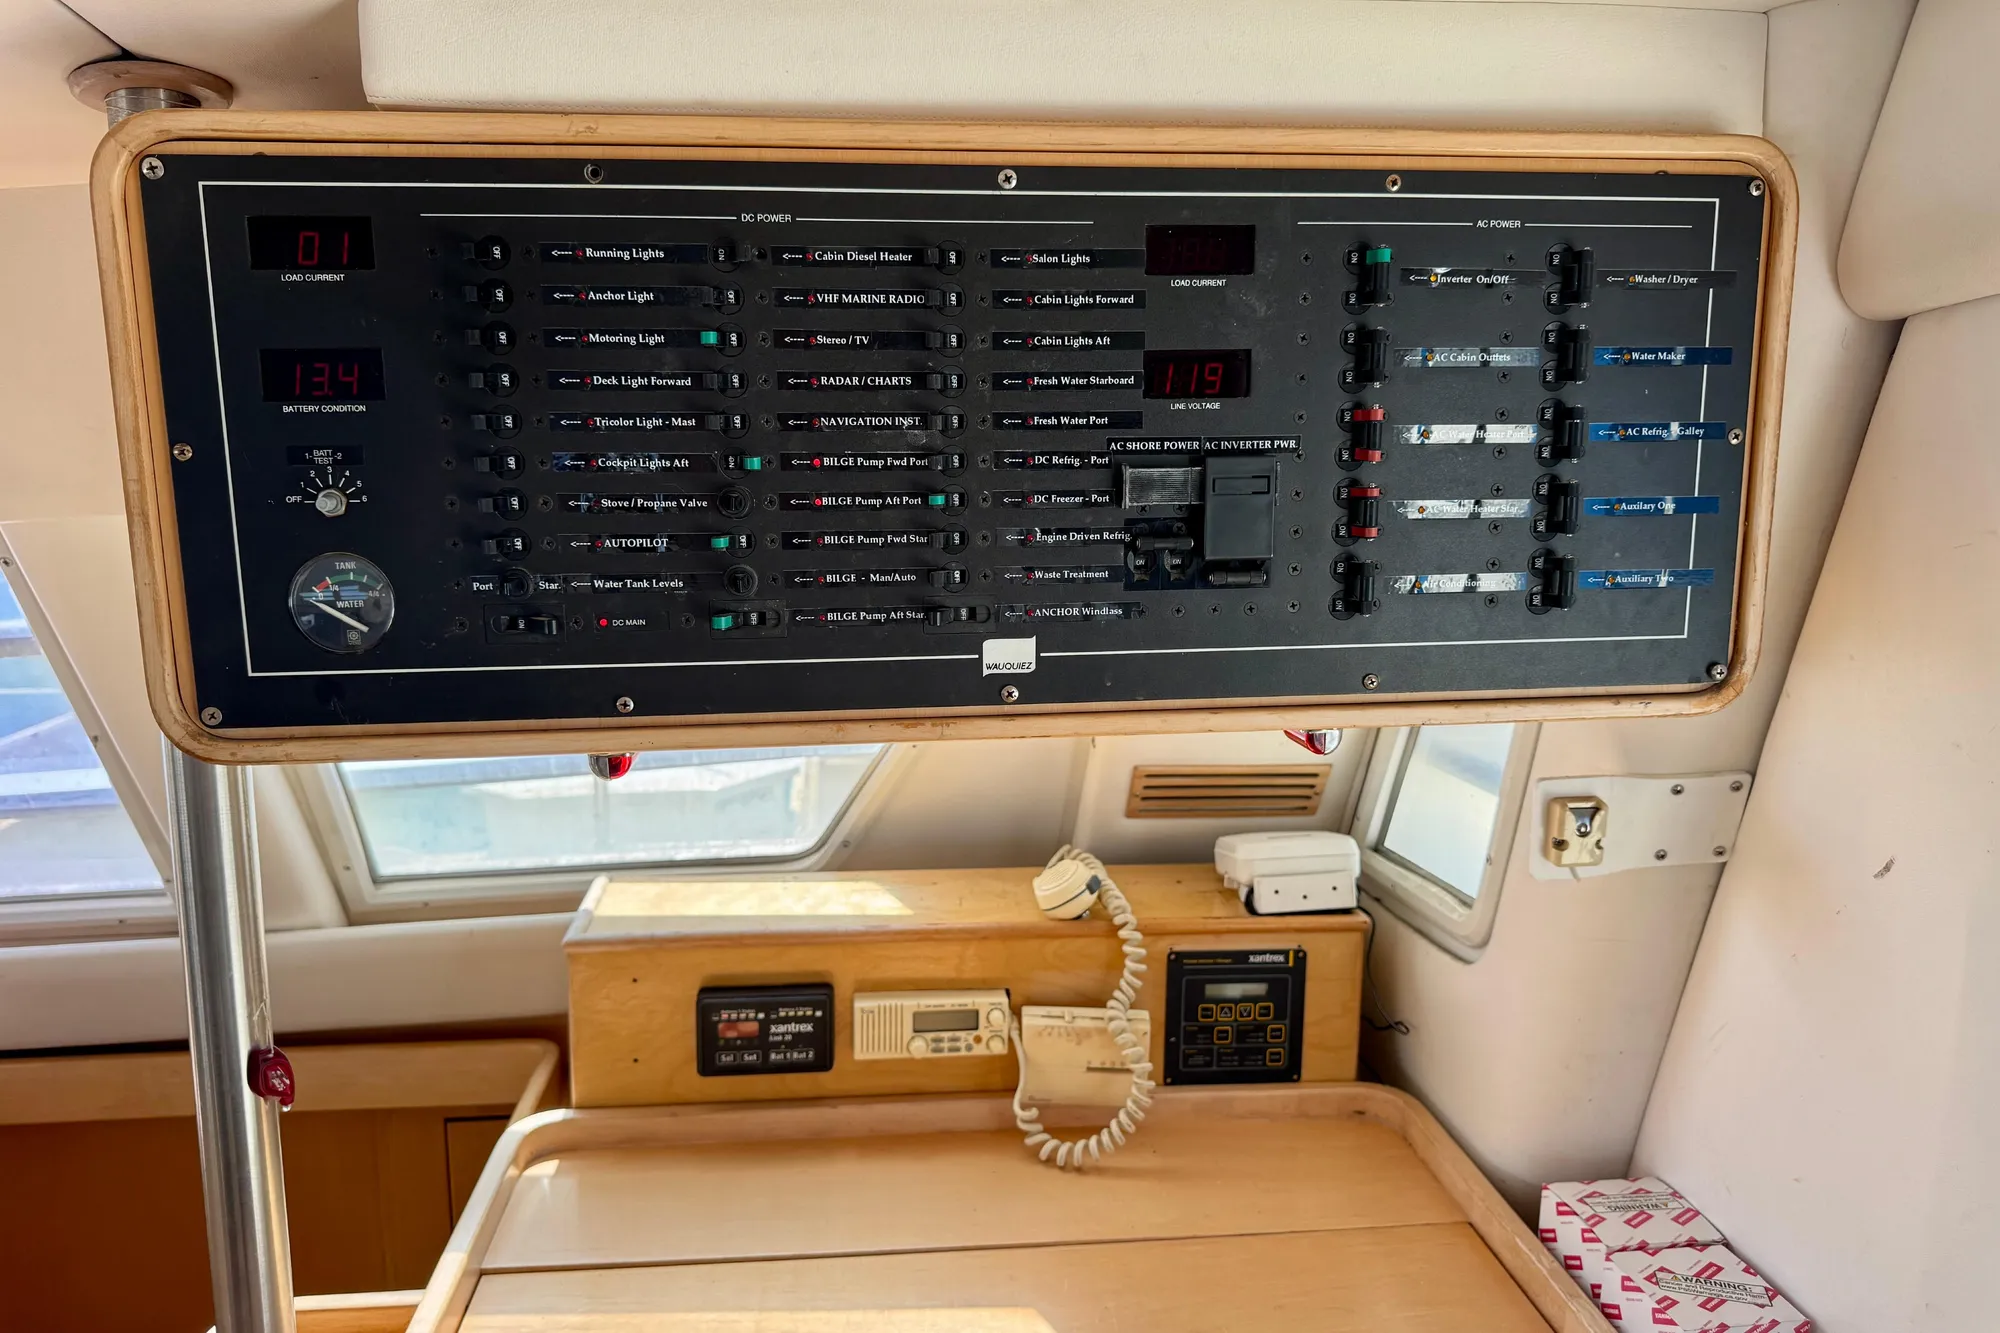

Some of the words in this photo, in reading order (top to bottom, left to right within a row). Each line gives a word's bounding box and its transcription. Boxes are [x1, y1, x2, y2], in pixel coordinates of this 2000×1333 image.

[742, 214, 754, 222] DC
[756, 214, 791, 222] POWER
[1490, 220, 1520, 228] POWER
[586, 248, 630, 260] Running
[633, 249, 664, 260] Lights
[815, 252, 843, 260] Cabin
[847, 252, 876, 260] Diesel
[880, 252, 912, 260] Heater
[1033, 254, 1058, 262] Salon
[1062, 254, 1090, 265] Lights
[1438, 275, 1472, 283] Inverter
[1477, 275, 1509, 283] On/Off
[1635, 275, 1666, 283] Washer
[1673, 275, 1698, 286] Dryer
[589, 291, 624, 300] Anchor
[627, 291, 654, 303] Light
[817, 294, 839, 302] VHF
[842, 294, 886, 303] MARINE
[889, 295, 924, 303] RADIO
[1035, 295, 1061, 303] Cabin
[1065, 295, 1093, 306] Lights
[1097, 295, 1133, 303] Forward
[589, 334, 636, 346] Motoring
[638, 334, 664, 345] Light
[817, 335, 846, 344] Stereo
[854, 336, 869, 344] TV
[1035, 337, 1061, 345] Cabin
[1065, 337, 1093, 348] Lights
[1096, 336, 1110, 344] Aft
[1434, 353, 1447, 361] AC
[1450, 353, 1476, 361] Cabin
[1479, 353, 1510, 361] Outlets
[1658, 352, 1685, 360] Maker
[593, 376, 618, 384] Deck
[622, 376, 648, 388] Light
[651, 377, 691, 385] Forward
[821, 377, 859, 385] RADAR
[868, 377, 911, 385] CHARTS
[1034, 377, 1057, 385] Fresh
[1090, 376, 1134, 384] Starboard
[594, 417, 634, 426] Tricolor
[636, 418, 662, 429] Light
[672, 418, 695, 426] Mast
[821, 417, 891, 425] NAVIGATION
[896, 417, 922, 426] INST.
[1090, 416, 1108, 424] Port
[1627, 428, 1639, 436] AC
[1678, 427, 1704, 437] Galley
[1110, 442, 1123, 450] AC
[1221, 441, 1271, 449] INVERTER
[1275, 440, 1298, 448] PWR.
[599, 458, 636, 469] Cockpit
[640, 458, 670, 469] Lights
[673, 459, 688, 467] Aft
[858, 458, 884, 468] Pump
[887, 457, 906, 465] Fwd
[1052, 456, 1082, 466] Refrig.
[1091, 456, 1108, 464] Port
[601, 499, 629, 507] Stove
[638, 499, 677, 510] Propane
[822, 497, 851, 505] BILGE
[856, 497, 882, 507] Pump
[1621, 503, 1654, 511] Auxilary
[858, 536, 884, 546] Pump
[888, 535, 906, 543] Fwd
[1036, 532, 1067, 542] Engine
[1070, 532, 1101, 540] Driven
[1103, 531, 1132, 542] Refrig.
[605, 539, 668, 547] AUTOPILOT
[827, 574, 857, 582] BILGE
[870, 573, 916, 581] Man/Auto
[1615, 575, 1652, 584] Auxiliary
[539, 581, 561, 589] Star.
[653, 579, 683, 587] Levels
[336, 600, 364, 608] WATER
[1035, 608, 1079, 616] ANCHOR
[1082, 607, 1122, 615] Windlass
[828, 612, 857, 620] BILGE
[860, 612, 886, 622] Pump
[890, 611, 904, 619] Aft
[985, 662, 1032, 670] WAUQUIEZ
[1248, 954, 1285, 963] xantrex
[769, 1023, 813, 1033] xantrex
[1681, 1276, 1752, 1292] WARNING:
